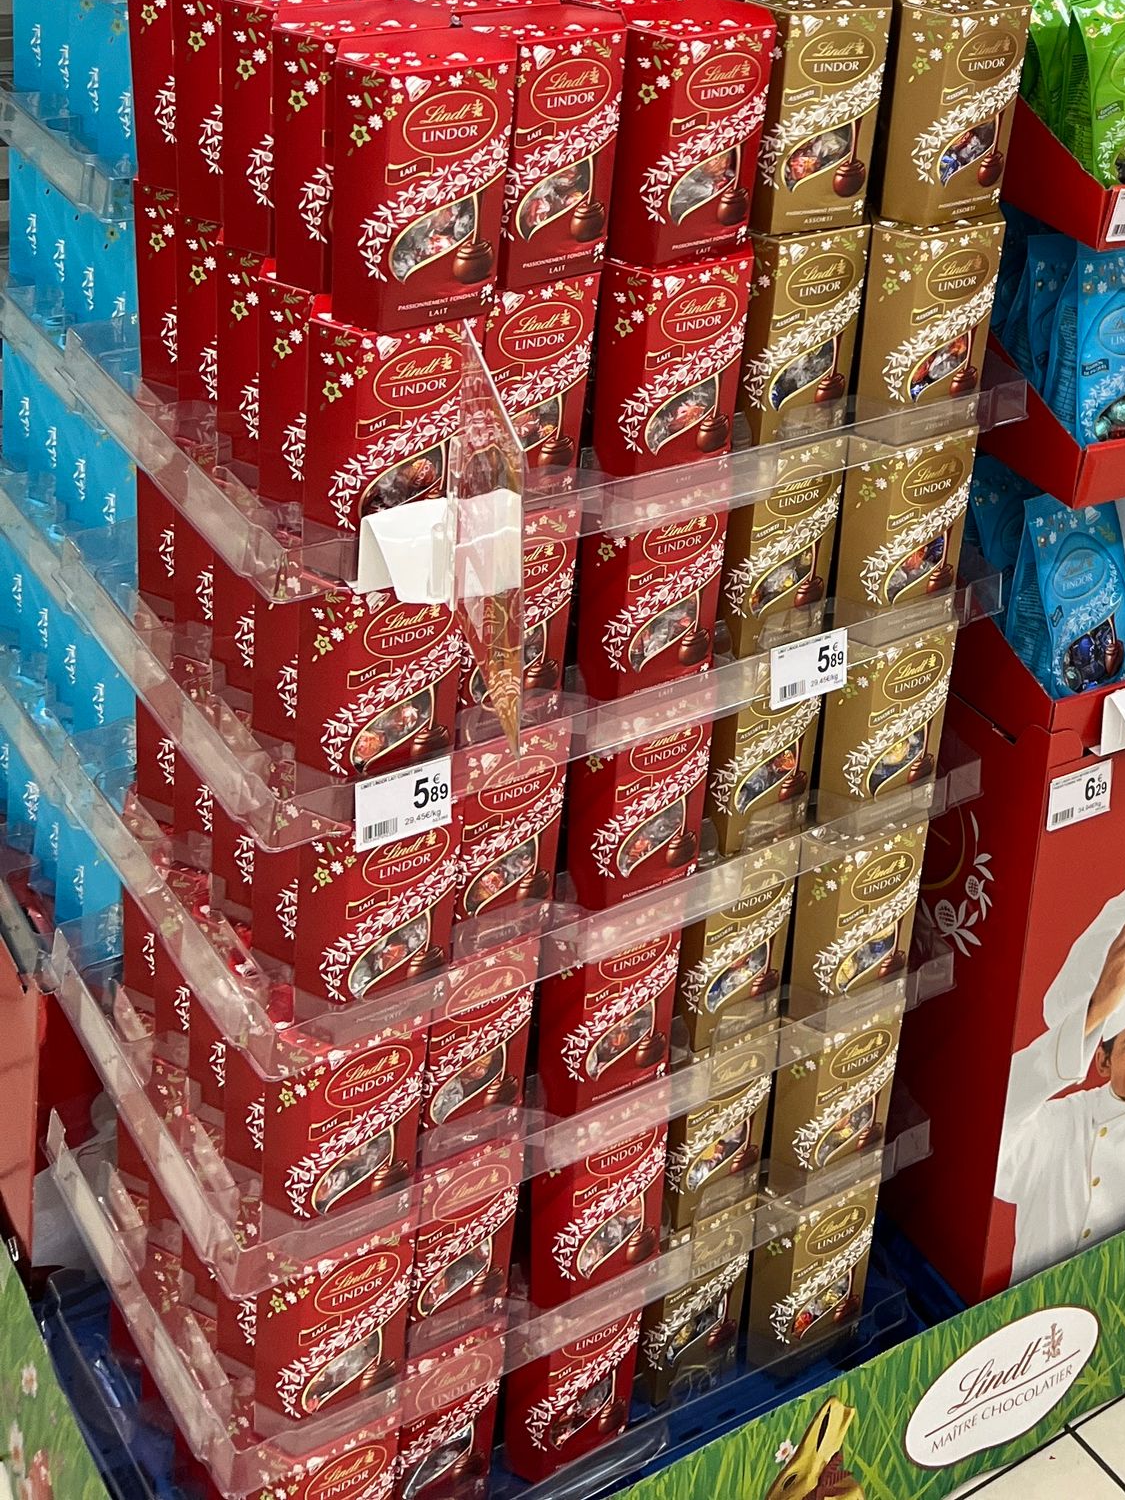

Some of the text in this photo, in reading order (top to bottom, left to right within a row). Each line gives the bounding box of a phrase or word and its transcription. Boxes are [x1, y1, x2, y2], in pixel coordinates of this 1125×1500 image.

[812, 42, 854, 56] Lindt
[813, 61, 859, 73] LINDOR
[968, 58, 1005, 72] LINDOR
[549, 71, 589, 90] Lindt
[546, 91, 595, 109] LINDOR
[420, 104, 470, 125] Lindt
[422, 124, 479, 143] LINDOR
[527, 128, 542, 141] LAIT
[400, 164, 417, 177] LAIT
[800, 280, 841, 297] LINDOR
[398, 291, 479, 311] PASSIONNEMENT FONDANT
[428, 307, 448, 317] LAIT
[392, 378, 447, 398] LINDOR
[381, 626, 435, 649] LINDOR
[360, 668, 378, 682] LAIT
[894, 673, 932, 694] LINDOR
[343, 1071, 395, 1101] LINDOR
[947, 1336, 1042, 1414] Lindt
[932, 1364, 1073, 1454] MAÎTRE CHOCOLATIER
